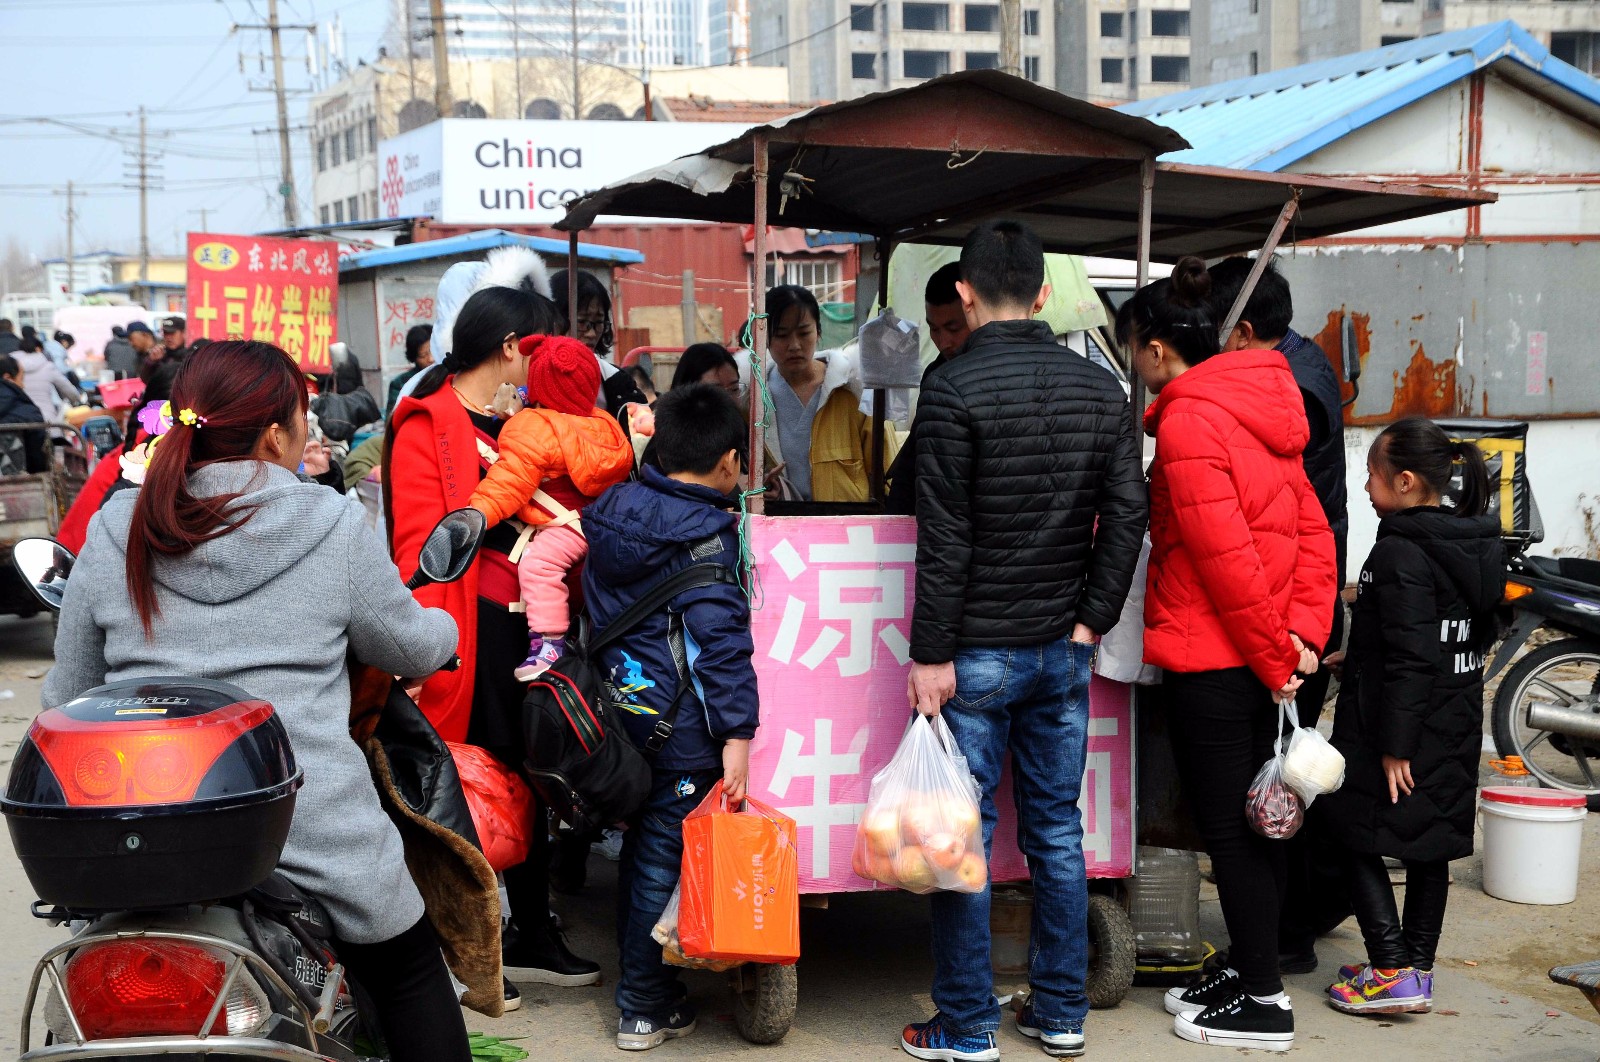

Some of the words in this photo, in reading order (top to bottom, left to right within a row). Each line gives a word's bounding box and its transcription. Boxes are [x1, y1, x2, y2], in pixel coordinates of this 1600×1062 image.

[475, 138, 582, 169] China
[479, 182, 600, 210] unico
[199, 247, 233, 266] 正宗
[247, 243, 333, 276] 东北风味
[768, 525, 918, 677] 凉
